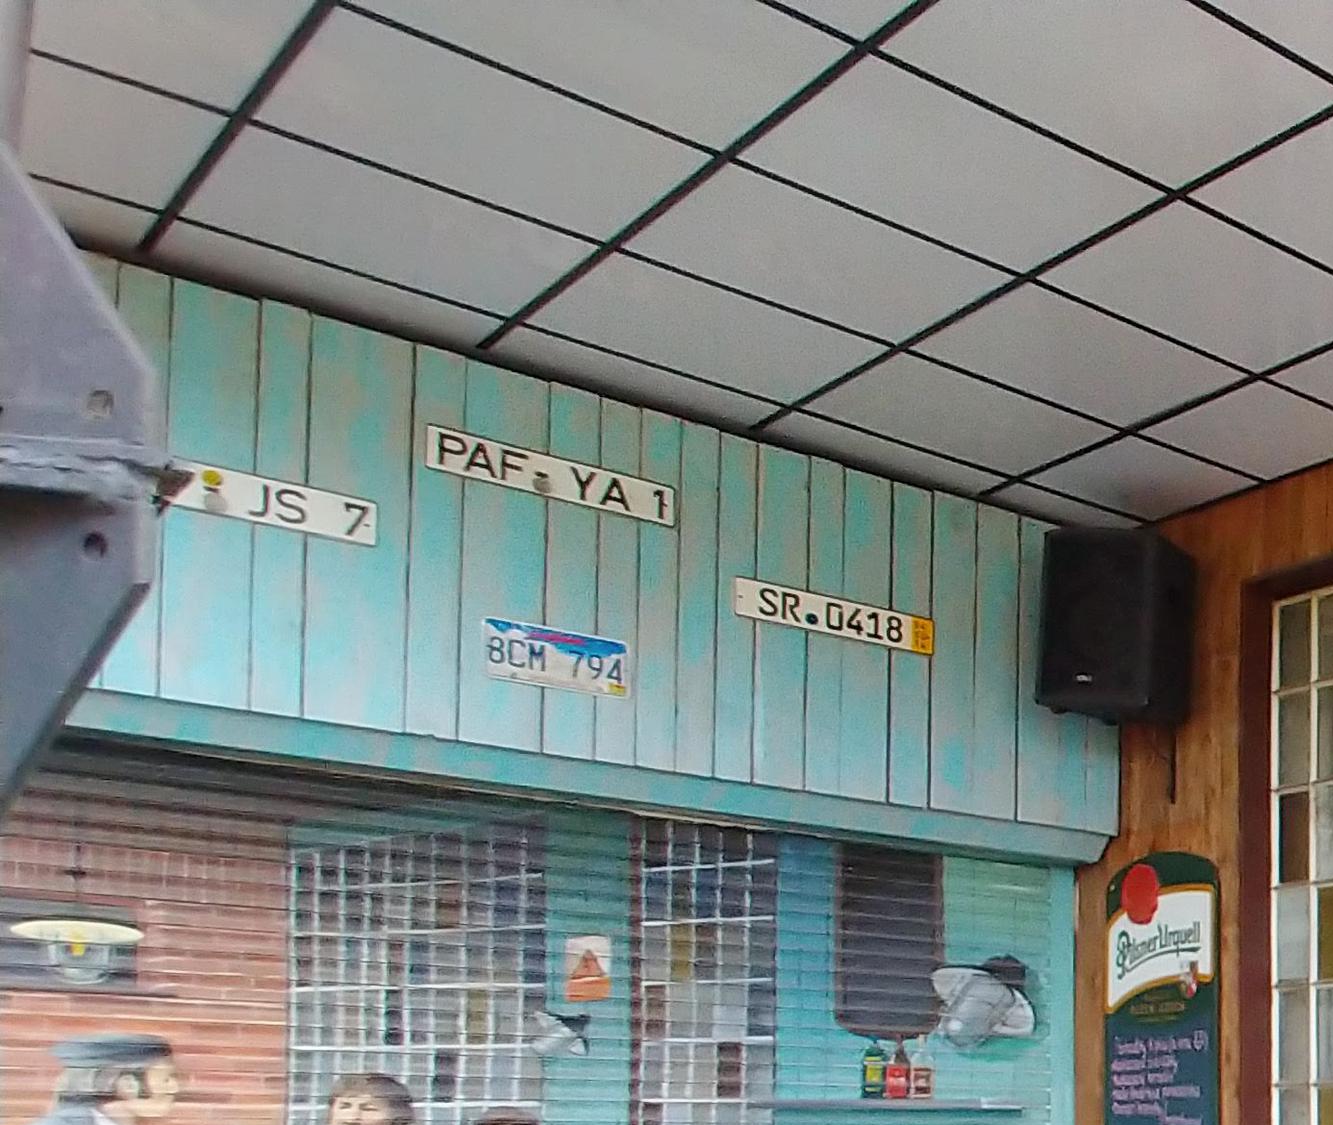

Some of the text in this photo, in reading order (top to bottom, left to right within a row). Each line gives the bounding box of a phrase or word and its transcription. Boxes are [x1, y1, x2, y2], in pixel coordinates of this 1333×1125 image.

[344, 503, 368, 535] 7
[653, 490, 667, 519] 1
[759, 588, 801, 623] SR
[826, 603, 903, 642] 0418
[570, 650, 622, 684] 794
